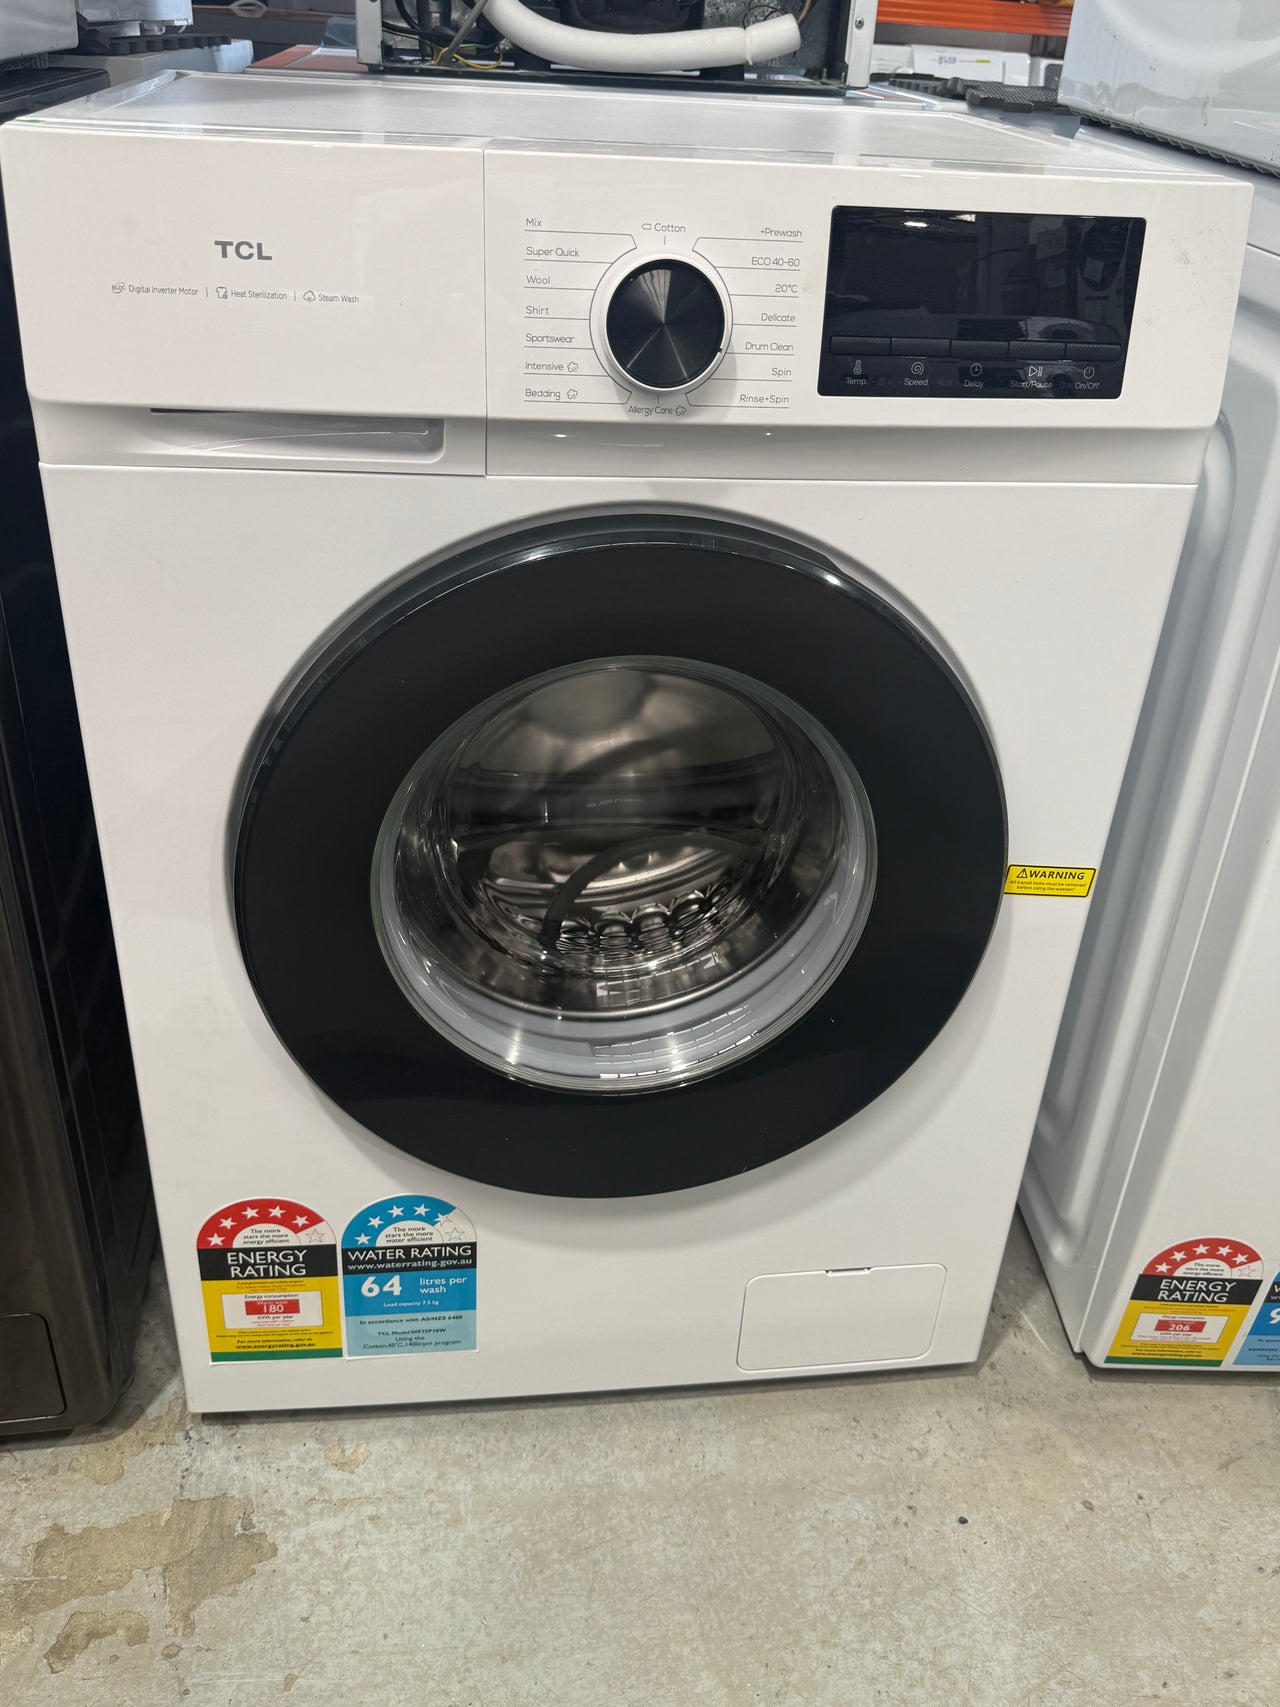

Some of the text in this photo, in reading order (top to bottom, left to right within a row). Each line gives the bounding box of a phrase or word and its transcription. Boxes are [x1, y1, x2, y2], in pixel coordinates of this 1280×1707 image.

[526, 217, 543, 227] Mix
[654, 222, 686, 233] Cotton
[760, 227, 802, 238] +Prewash
[214, 240, 273, 261] TCL
[526, 246, 580, 258] Super Quick
[526, 275, 551, 285] Wool
[128, 284, 199, 296] Digital Inverter Motor
[774, 283, 799, 294] 20°C
[230, 289, 288, 300] Heat Sterilization
[318, 293, 360, 304] Steam Wash
[526, 305, 550, 315] Shirt
[760, 312, 797, 322] Delicate
[525, 332, 576, 344] Sportswear
[745, 341, 795, 352] Drum Clean
[525, 360, 564, 371] Intensive
[771, 367, 792, 378] Spin
[846, 376, 868, 387] Temp.
[903, 377, 929, 388] Speed
[963, 379, 984, 390] Delay
[1010, 380, 1053, 390] Start/Pause
[1074, 381, 1100, 391] On/Off
[525, 388, 561, 400] Bedding
[739, 394, 790, 405] Rinse+Spin
[627, 405, 673, 417] Allergy Care
[1029, 870, 1085, 880] WARNING
[227, 1250, 307, 1265] ENERGY
[347, 1245, 472, 1261] WATER RATING
[347, 1258, 473, 1270] www.waterrating.gov.au
[230, 1263, 307, 1278] RATING
[360, 1274, 402, 1297] 64
[419, 1276, 468, 1286] litres per
[1159, 1278, 1237, 1292] ENERGY
[419, 1285, 447, 1294] wash
[1157, 1290, 1229, 1303] RATING
[263, 1304, 285, 1313] 180
